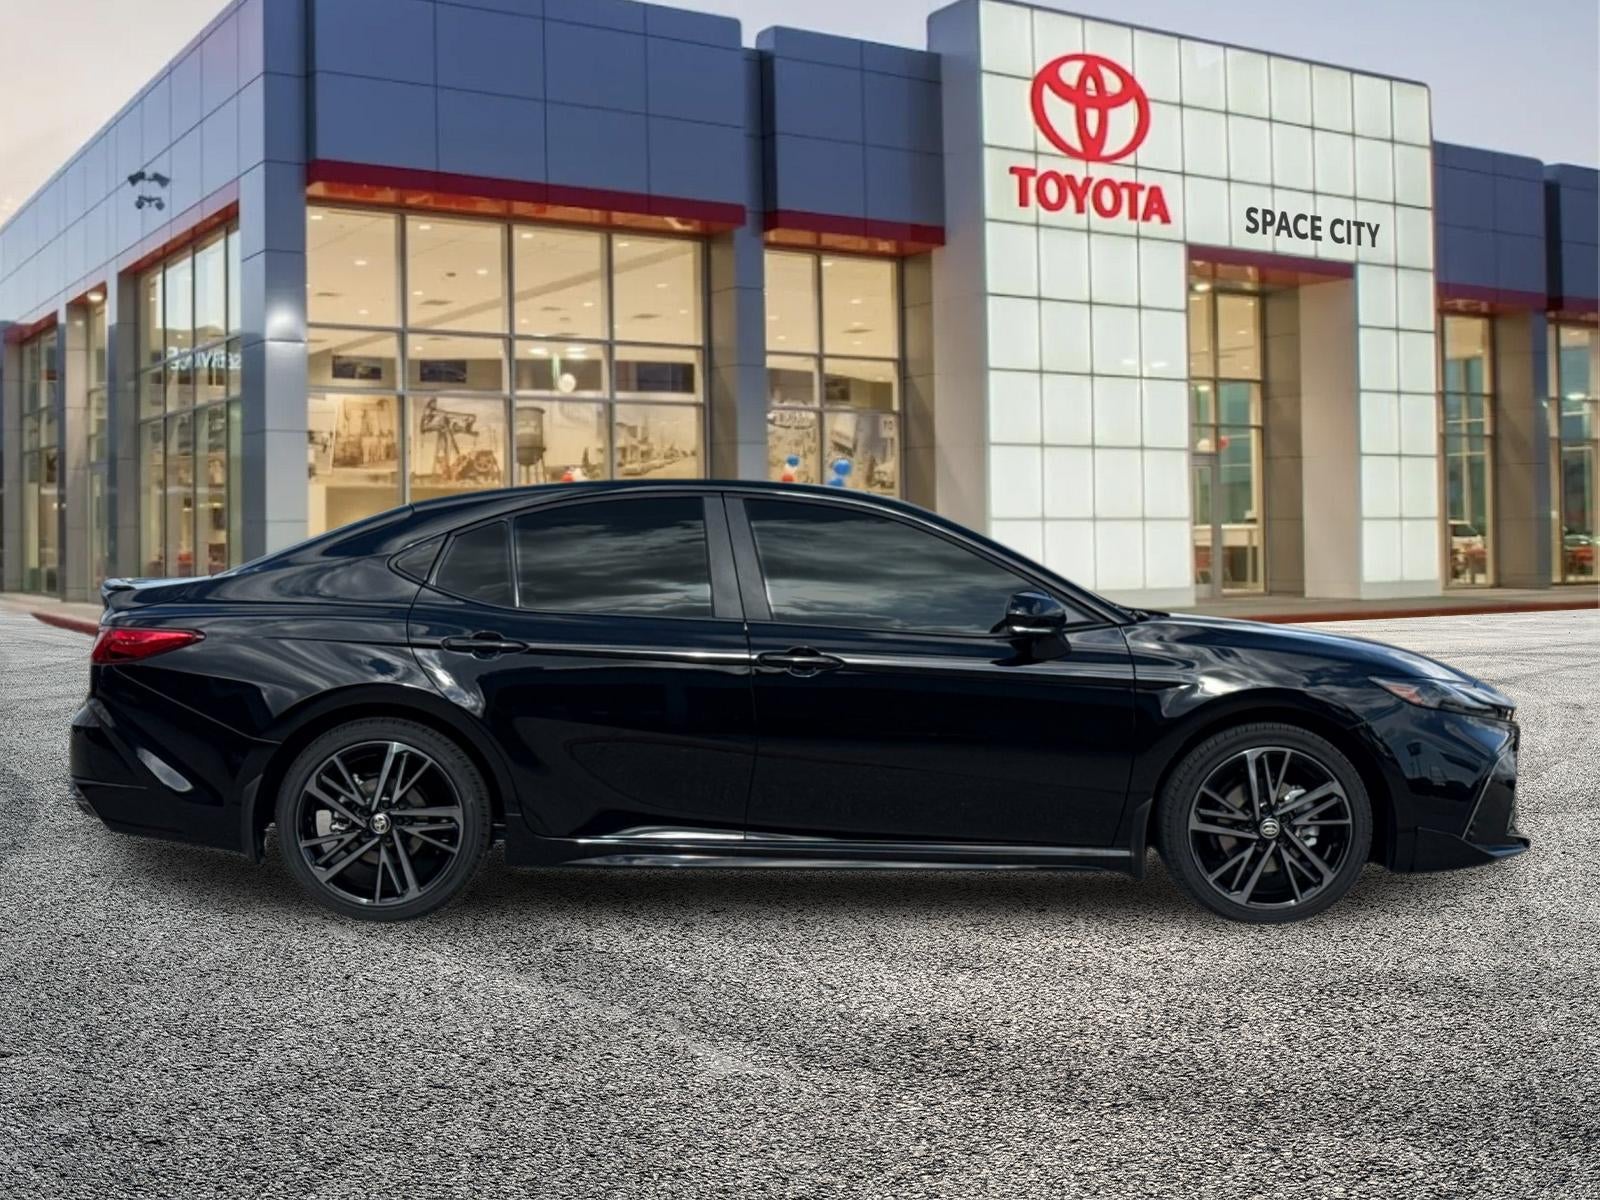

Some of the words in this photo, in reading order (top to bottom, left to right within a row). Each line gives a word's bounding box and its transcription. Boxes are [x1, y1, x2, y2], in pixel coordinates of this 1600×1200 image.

[1009, 166, 1171, 224] TOYOTA
[1245, 206, 1323, 241] SPACE
[1329, 217, 1381, 248] CITY
